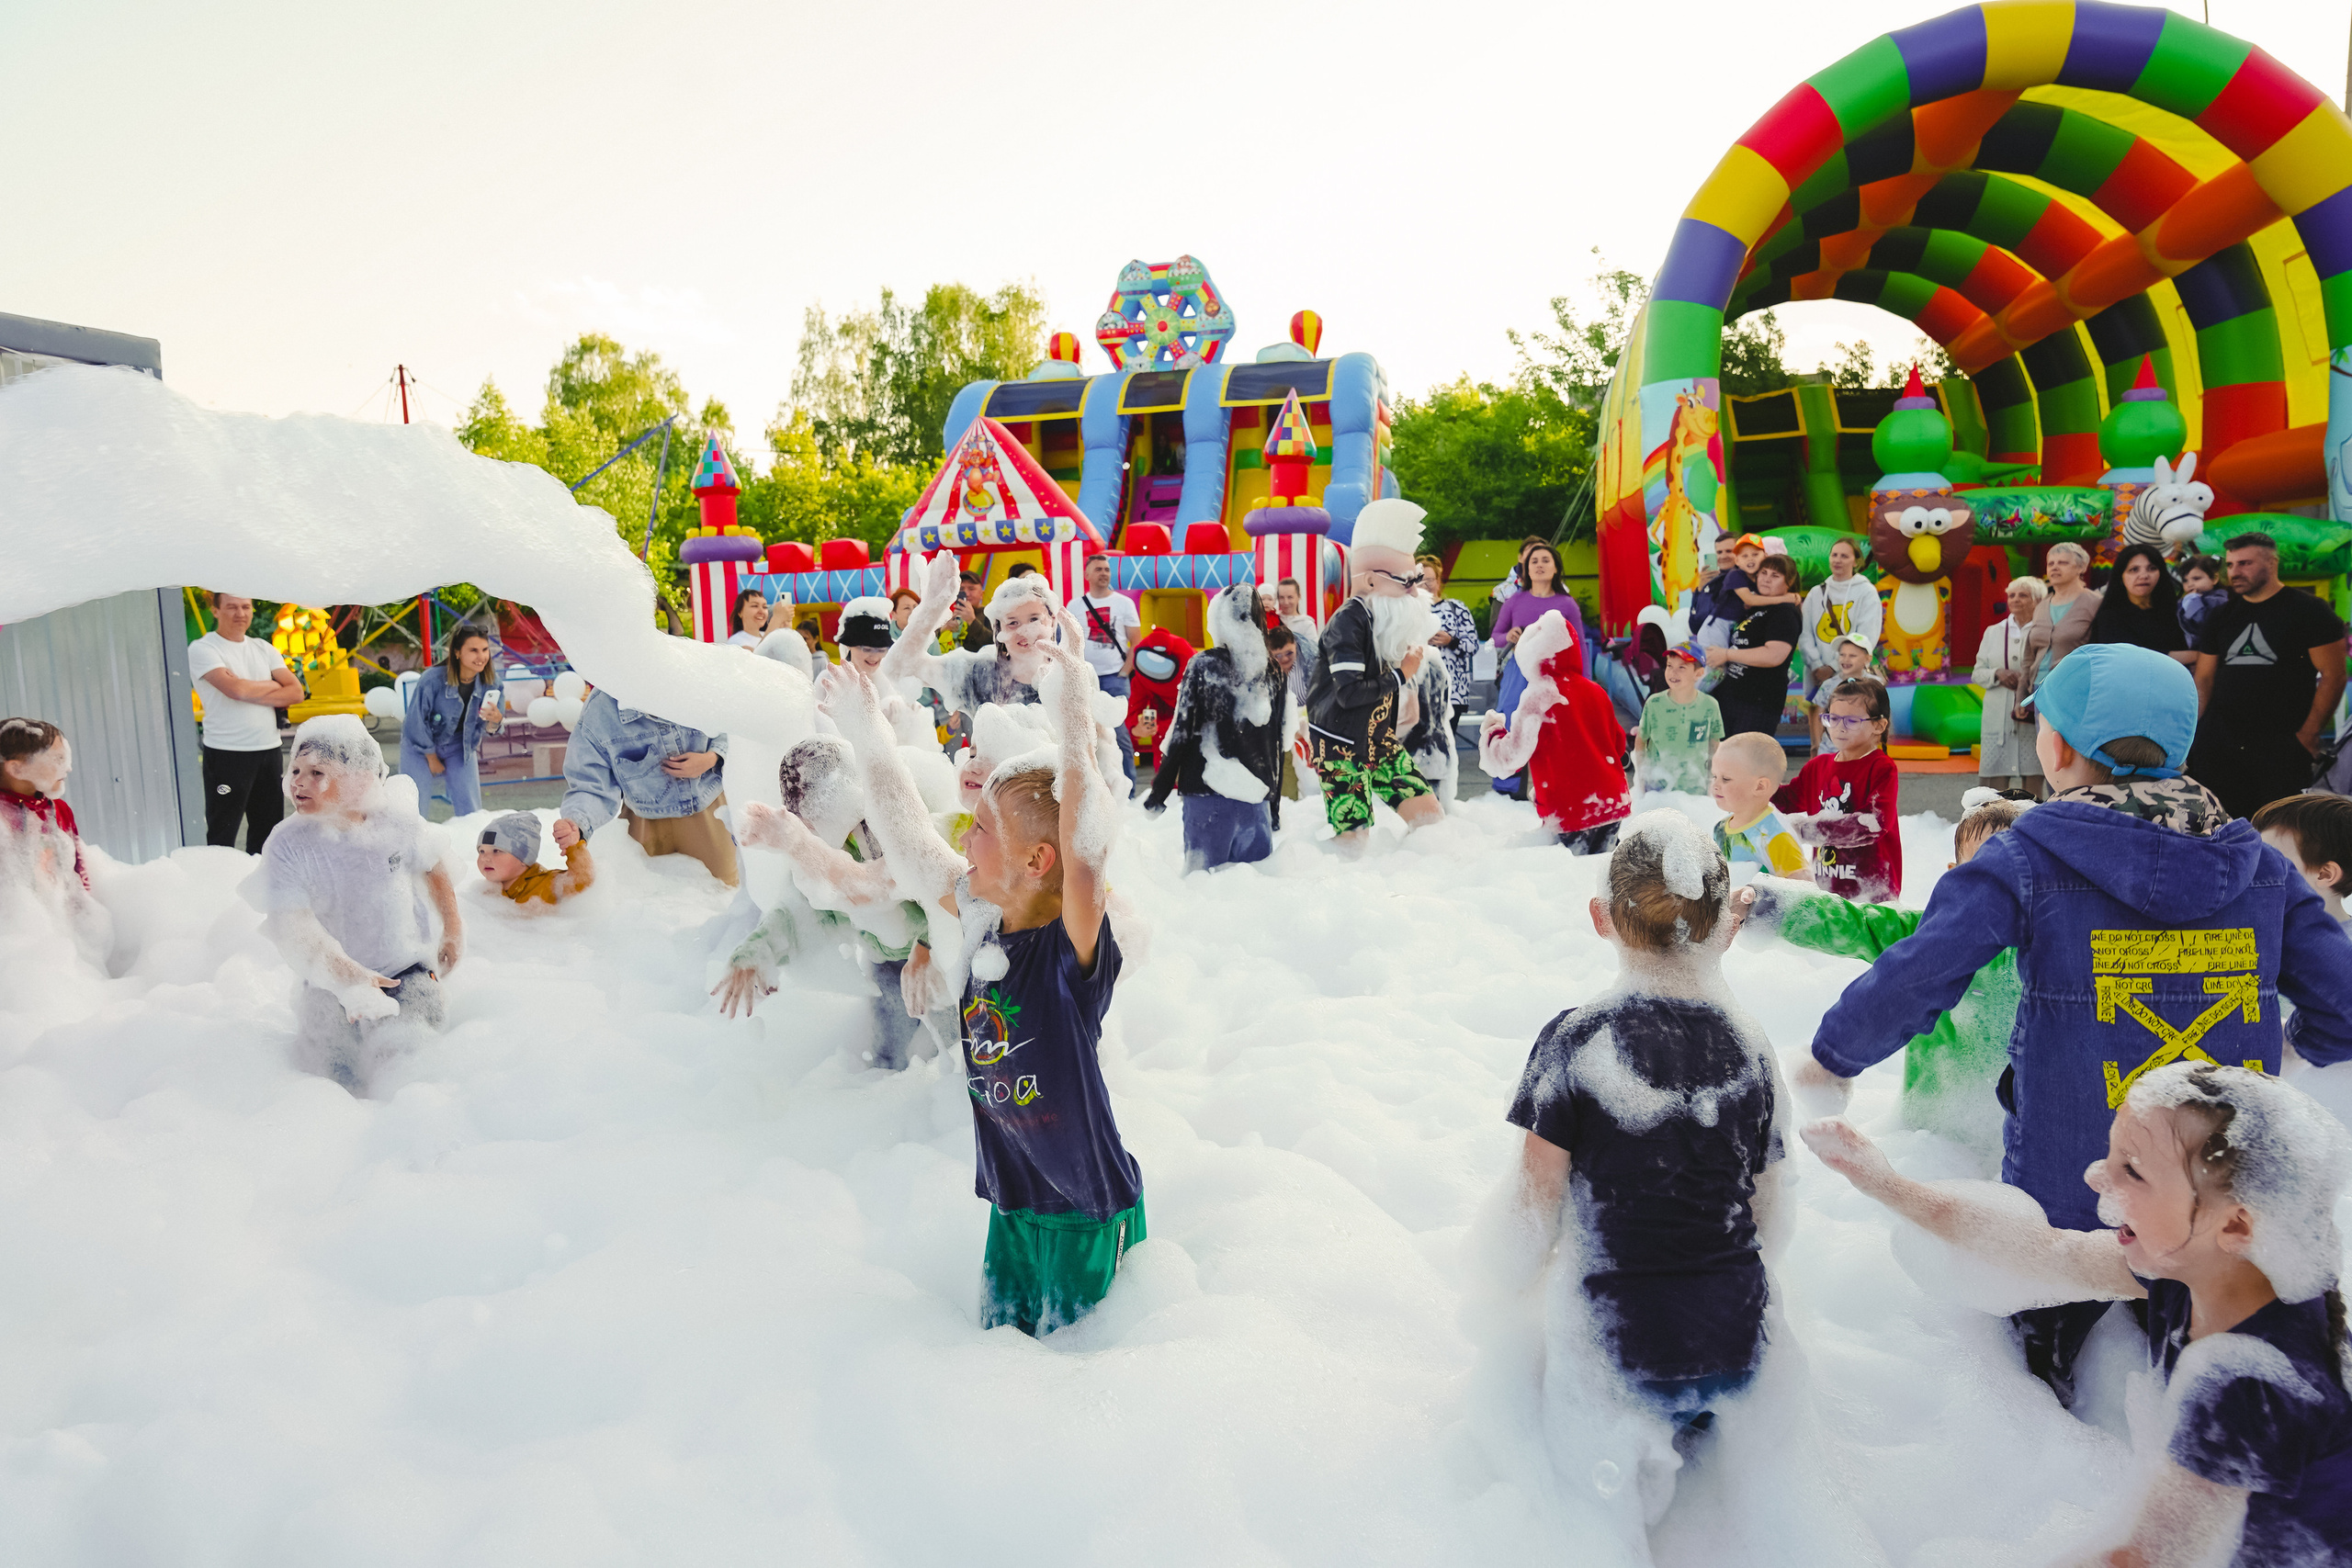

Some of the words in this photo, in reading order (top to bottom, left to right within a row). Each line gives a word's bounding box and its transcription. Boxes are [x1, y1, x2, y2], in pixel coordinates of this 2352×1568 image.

[2109, 933, 2122, 942] DO
[2124, 933, 2143, 942] NOT
[2145, 933, 2176, 942] CROSS
[2204, 932, 2222, 942] FIRE
[2225, 931, 2243, 941] LINE
[2098, 947, 2117, 955] NOT
[2119, 947, 2150, 956] CROSS
[2128, 961, 2144, 970] NOT
[2146, 961, 2179, 971] CROSS
[2208, 961, 2227, 970] FIRE
[2229, 960, 2247, 969] LINE
[2115, 980, 2133, 990] NOT
[2135, 981, 2153, 990] CRO
[2205, 980, 2224, 990] LINE
